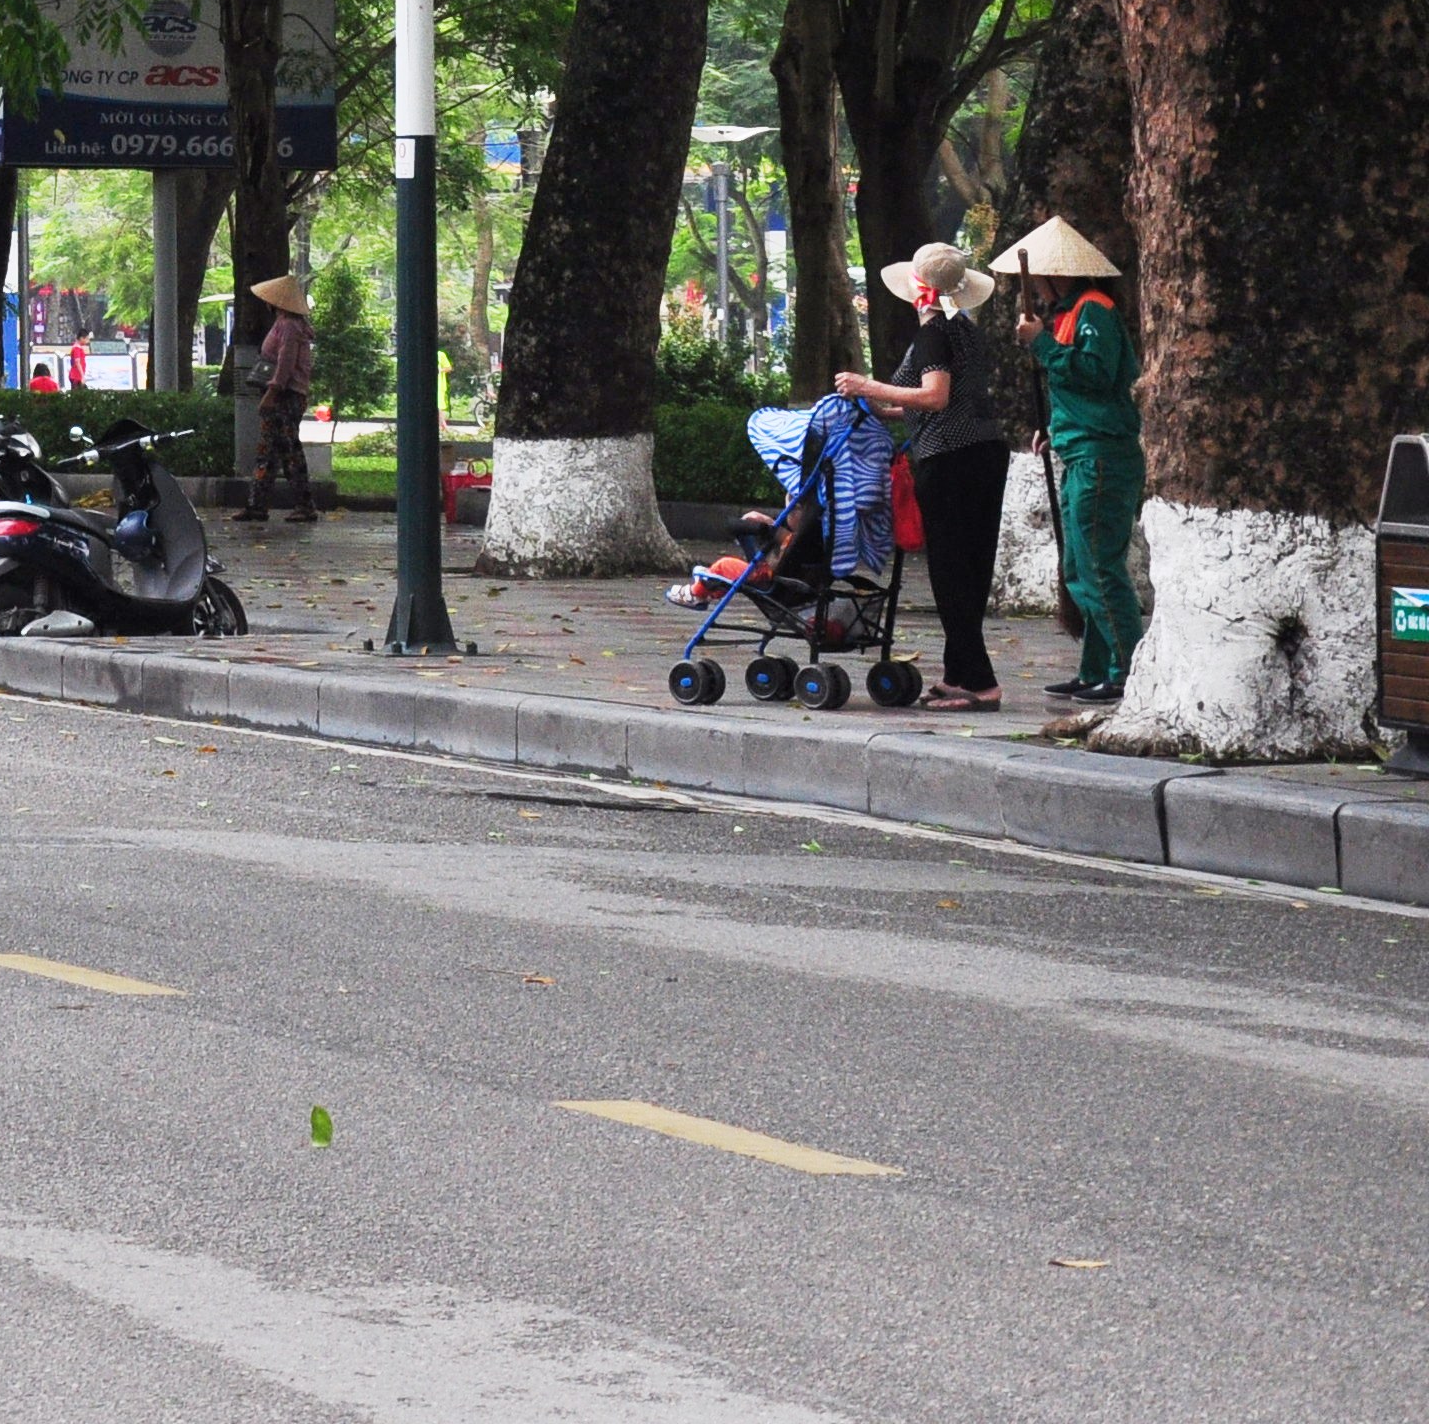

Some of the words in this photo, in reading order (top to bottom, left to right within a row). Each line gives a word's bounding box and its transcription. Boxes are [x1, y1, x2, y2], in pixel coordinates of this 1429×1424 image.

[98, 70, 115, 84] TY
[117, 70, 139, 85] CP
[144, 65, 221, 87] acs
[206, 111, 231, 125] CÁ
